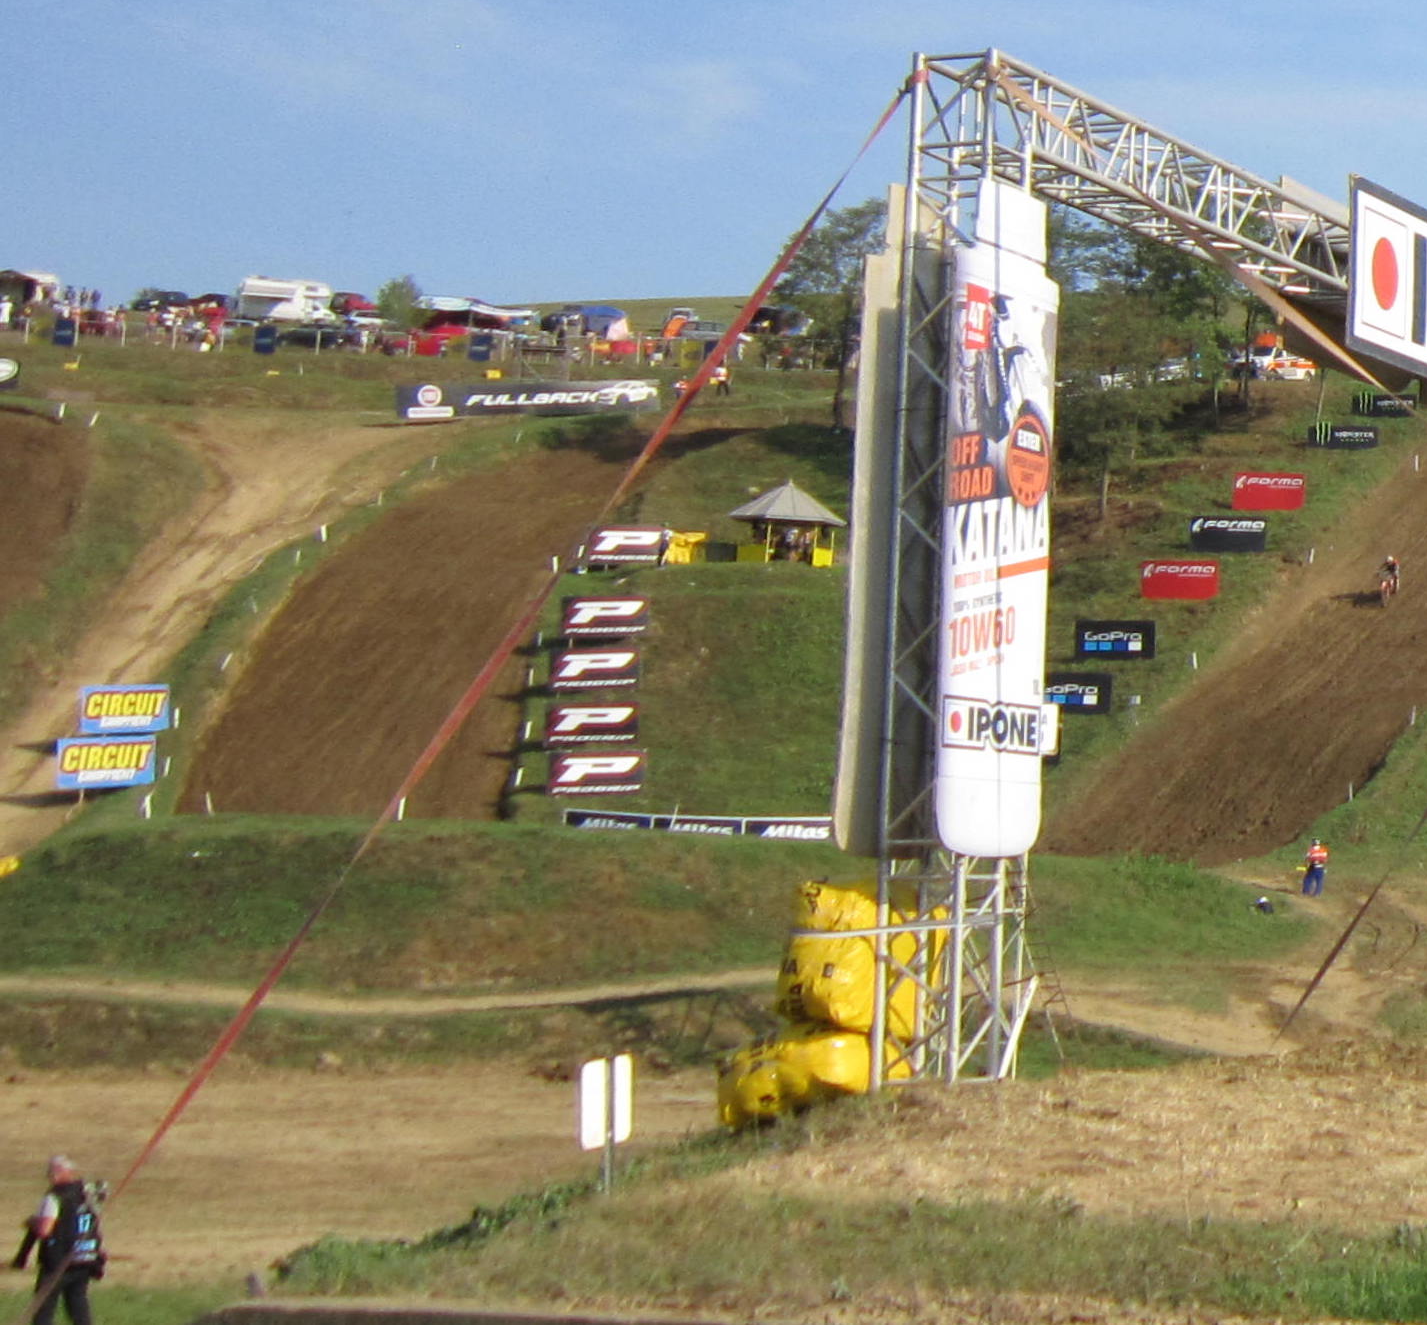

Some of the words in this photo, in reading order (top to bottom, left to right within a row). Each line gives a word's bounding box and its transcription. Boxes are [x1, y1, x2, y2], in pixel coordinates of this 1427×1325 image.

[465, 390, 599, 407] FULLBACK
[947, 496, 1049, 568] KATANA
[949, 606, 1016, 659] 10W60
[1084, 631, 1143, 641] GoPro
[86, 691, 168, 718] CIRCUIT
[967, 706, 1038, 748] IPONE
[61, 743, 153, 772] CIRCUIT
[761, 825, 831, 840] Mitas
